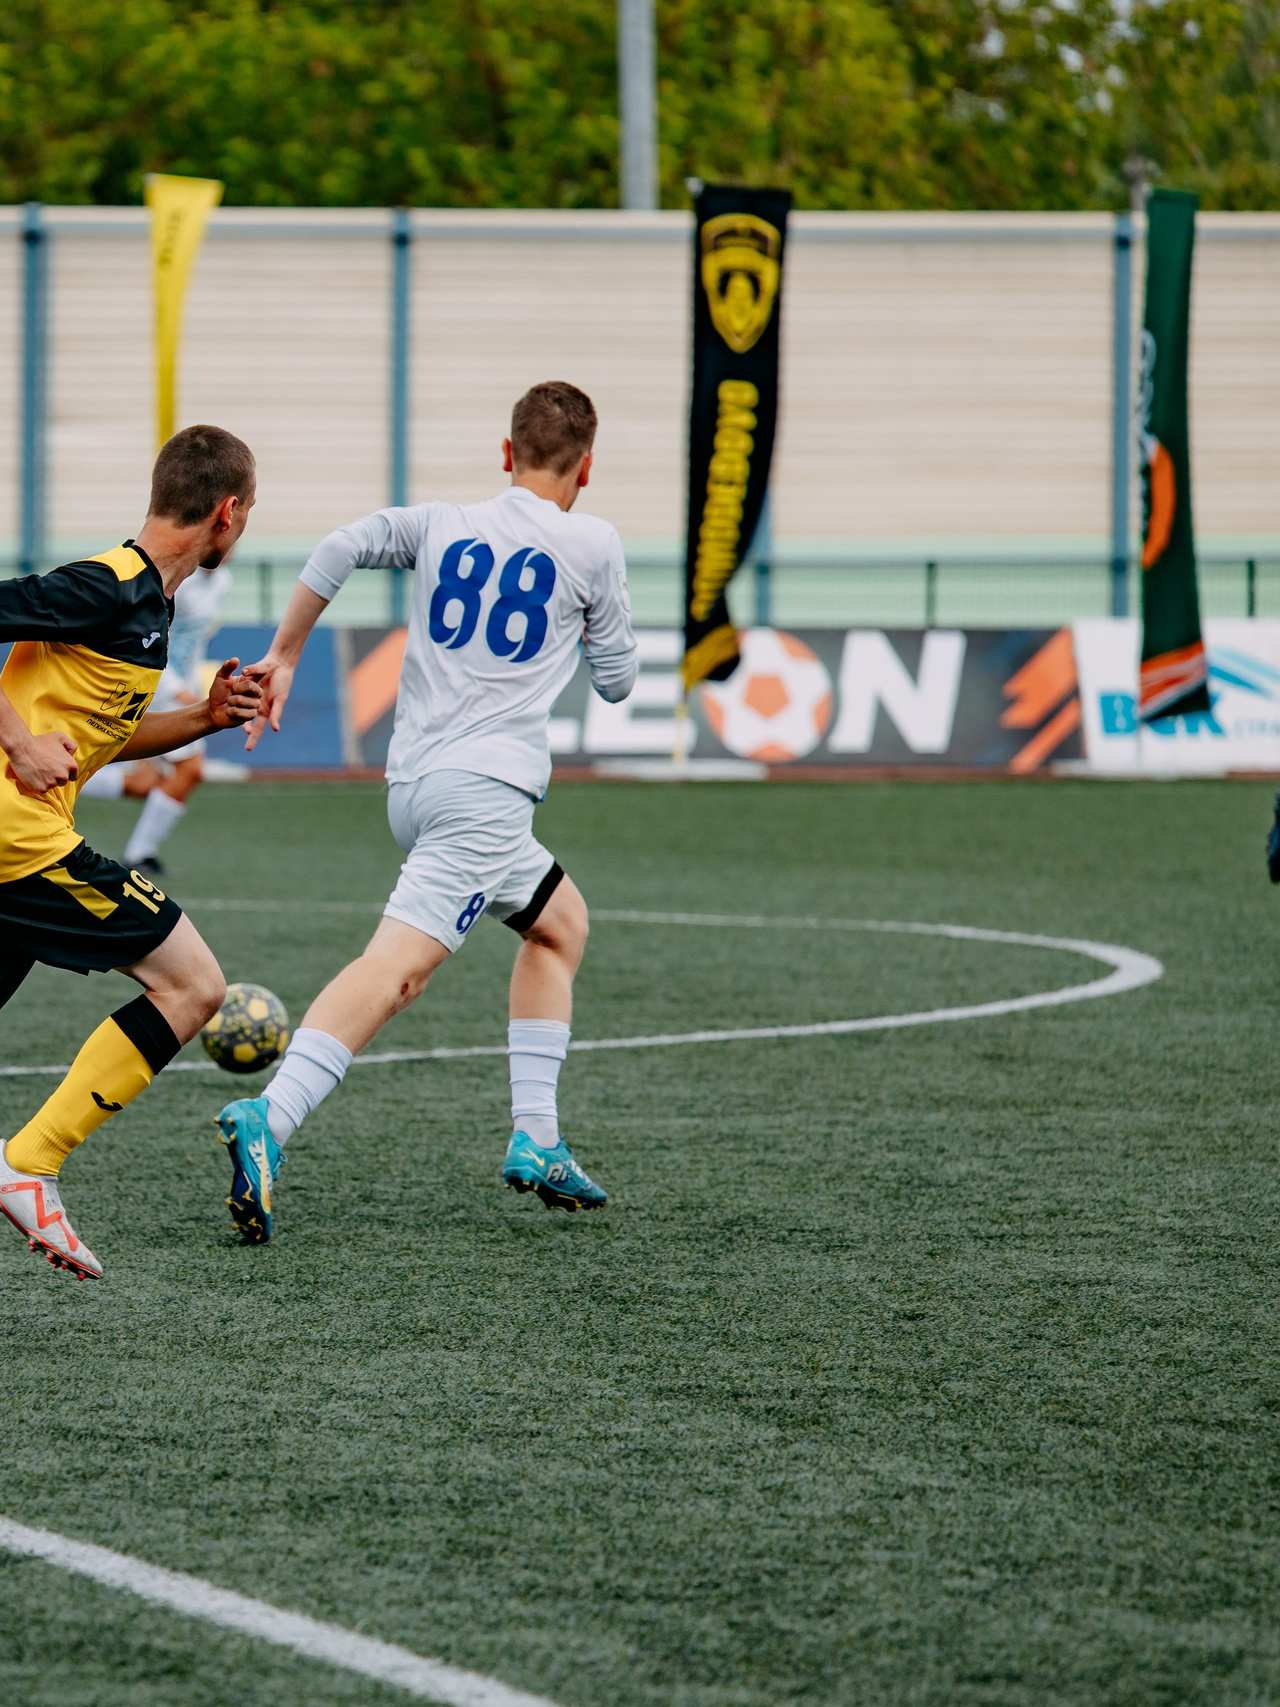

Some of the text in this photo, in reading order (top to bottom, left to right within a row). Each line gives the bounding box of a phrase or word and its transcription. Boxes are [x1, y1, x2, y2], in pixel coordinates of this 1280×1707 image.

[429, 537, 556, 663] 88
[122, 869, 166, 915] 19
[456, 892, 487, 935] 8
